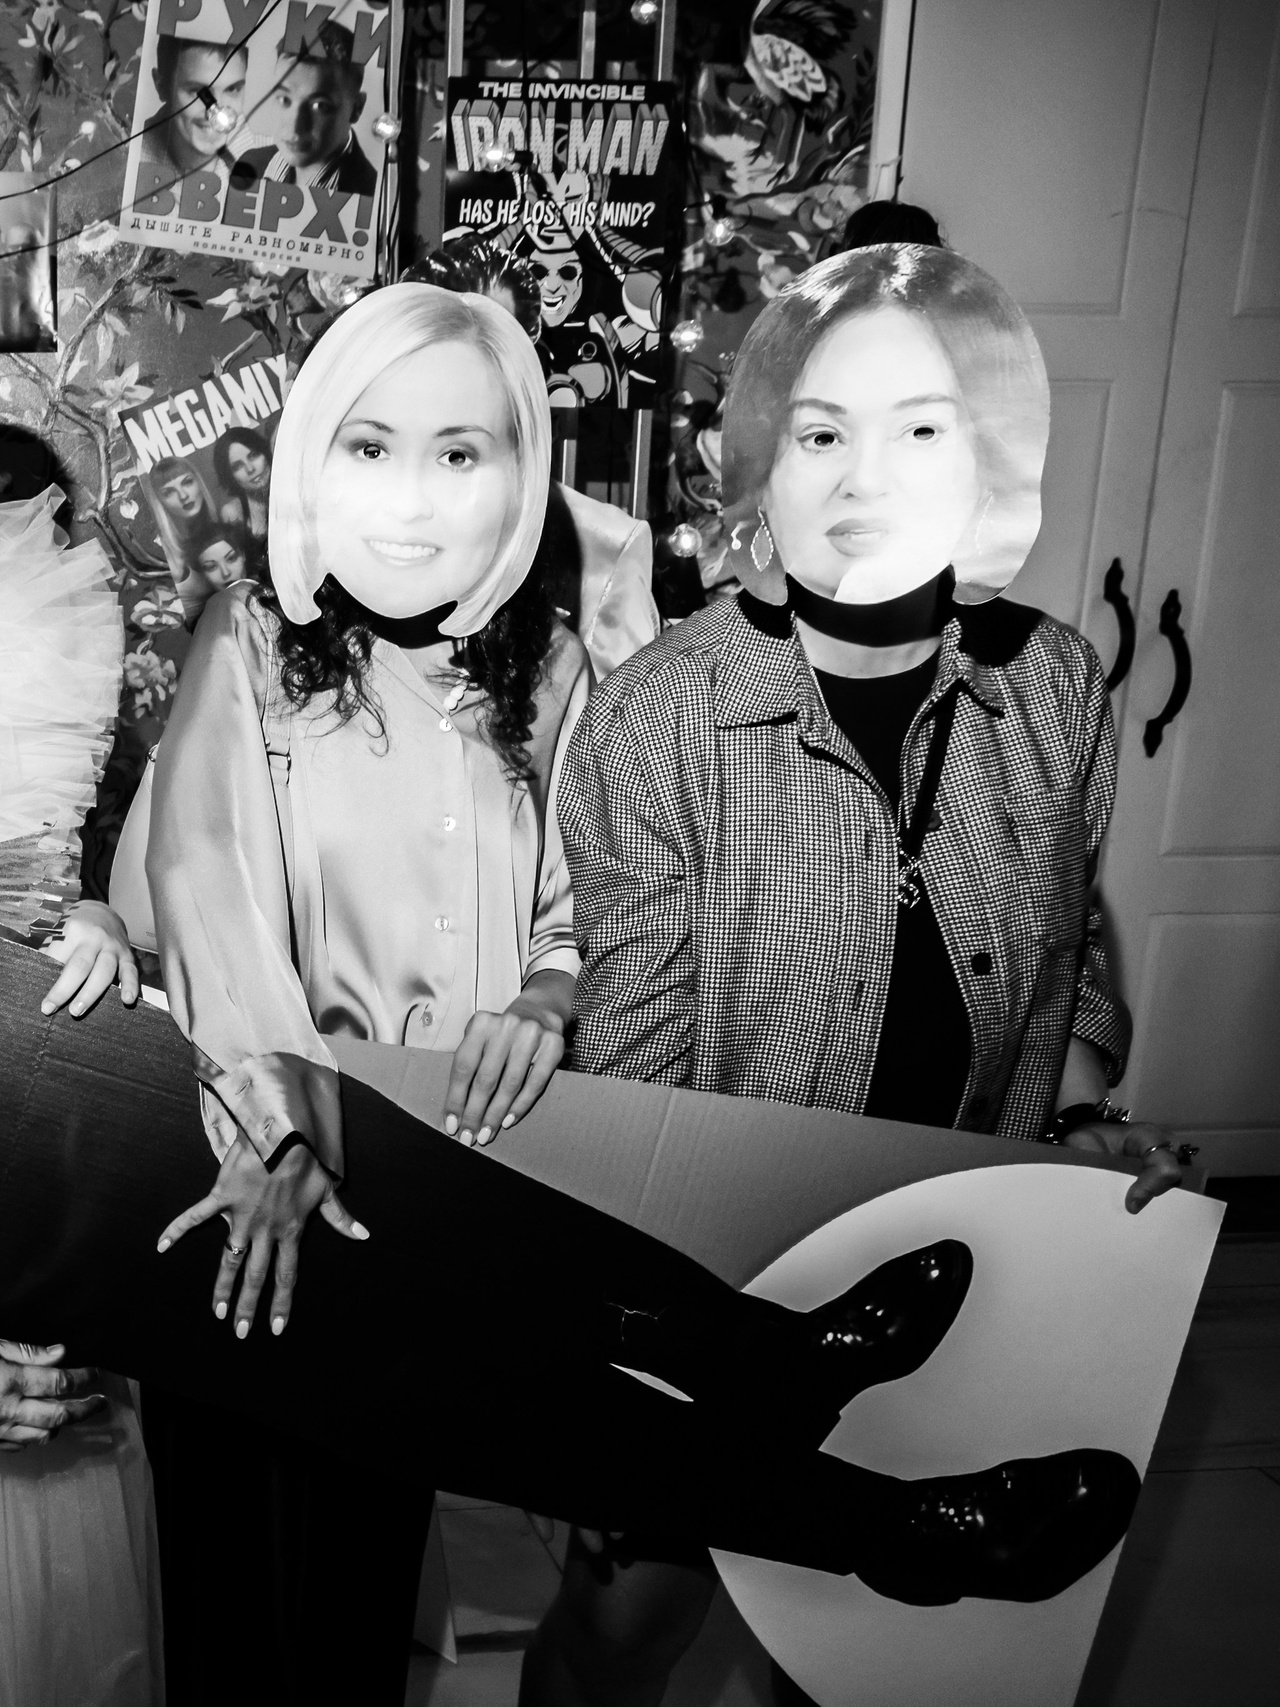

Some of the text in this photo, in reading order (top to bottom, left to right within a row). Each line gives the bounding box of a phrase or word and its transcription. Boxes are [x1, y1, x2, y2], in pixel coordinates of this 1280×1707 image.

[157, 0, 389, 68] РУКИ
[479, 81, 646, 101] THE INVINCIBLE
[451, 98, 670, 176] IRON MAN
[132, 161, 372, 247] ВВЕРХ!
[459, 198, 493, 223] HAS
[497, 199, 519, 224] HE
[569, 201, 598, 227] HIS
[600, 201, 656, 228] MIND?
[131, 217, 365, 262] ДЫШИТЕ РАВНОМЕРНО
